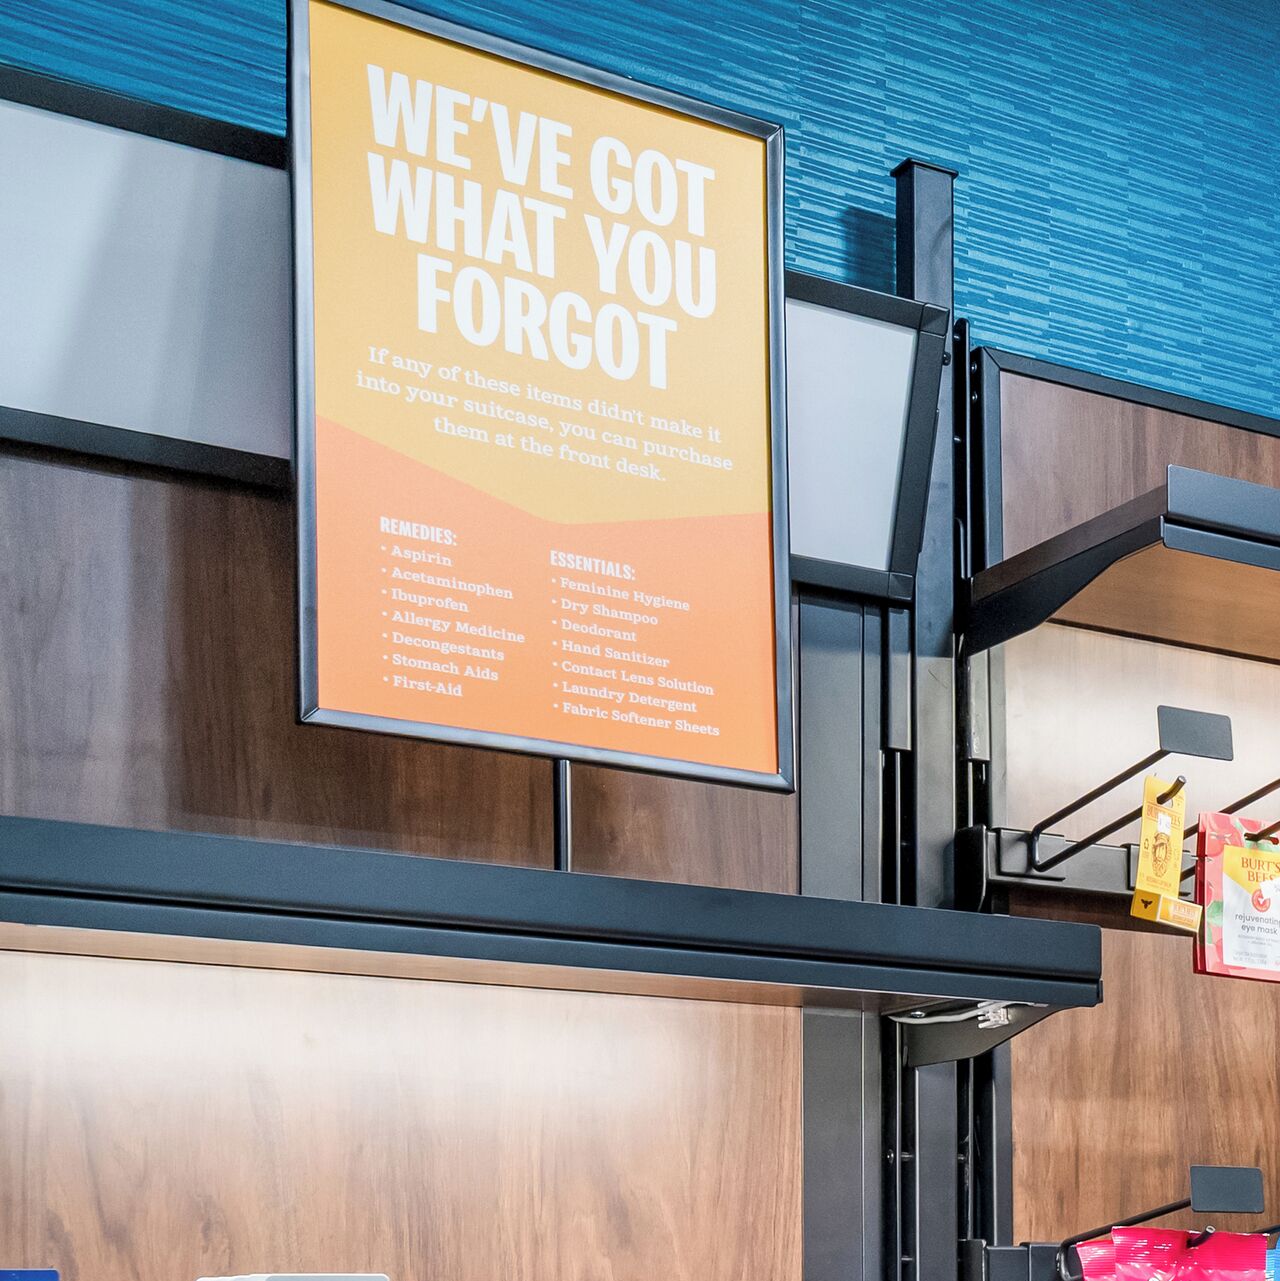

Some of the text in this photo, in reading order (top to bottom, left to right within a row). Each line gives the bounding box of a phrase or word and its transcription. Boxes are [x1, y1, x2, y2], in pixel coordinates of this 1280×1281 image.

[366, 64, 715, 236] WE'VE GOT
[367, 152, 716, 318] WHAT YOU
[418, 253, 677, 389] FORGOT
[369, 347, 721, 442] If any of these items didn't make it
[356, 371, 733, 471] into your suitcase, you can purchase
[434, 417, 666, 481] them at the front desk.
[380, 516, 457, 545] REMEDIES:
[392, 545, 453, 567] Aspirin
[550, 550, 635, 580] ESSENTIALS:
[392, 568, 513, 600] Acetaminophen
[560, 577, 689, 611] Feminine Hygiene
[392, 588, 468, 613] Ibuprofen
[561, 598, 658, 626] Dry Shampoo
[393, 610, 525, 643] Allergy Medicine
[562, 619, 636, 642] Deodorant
[393, 632, 504, 661] Decongestants
[562, 640, 669, 667] Hand Sanitizer
[393, 653, 498, 681] Stomach Aids
[562, 661, 714, 696] Contact Lens Solution
[393, 675, 462, 697] First-Aid
[563, 681, 696, 713] Laundry Detergent
[563, 703, 719, 736] Fabric Softener Sheets
[1241, 857, 1280, 873] BURT'S
